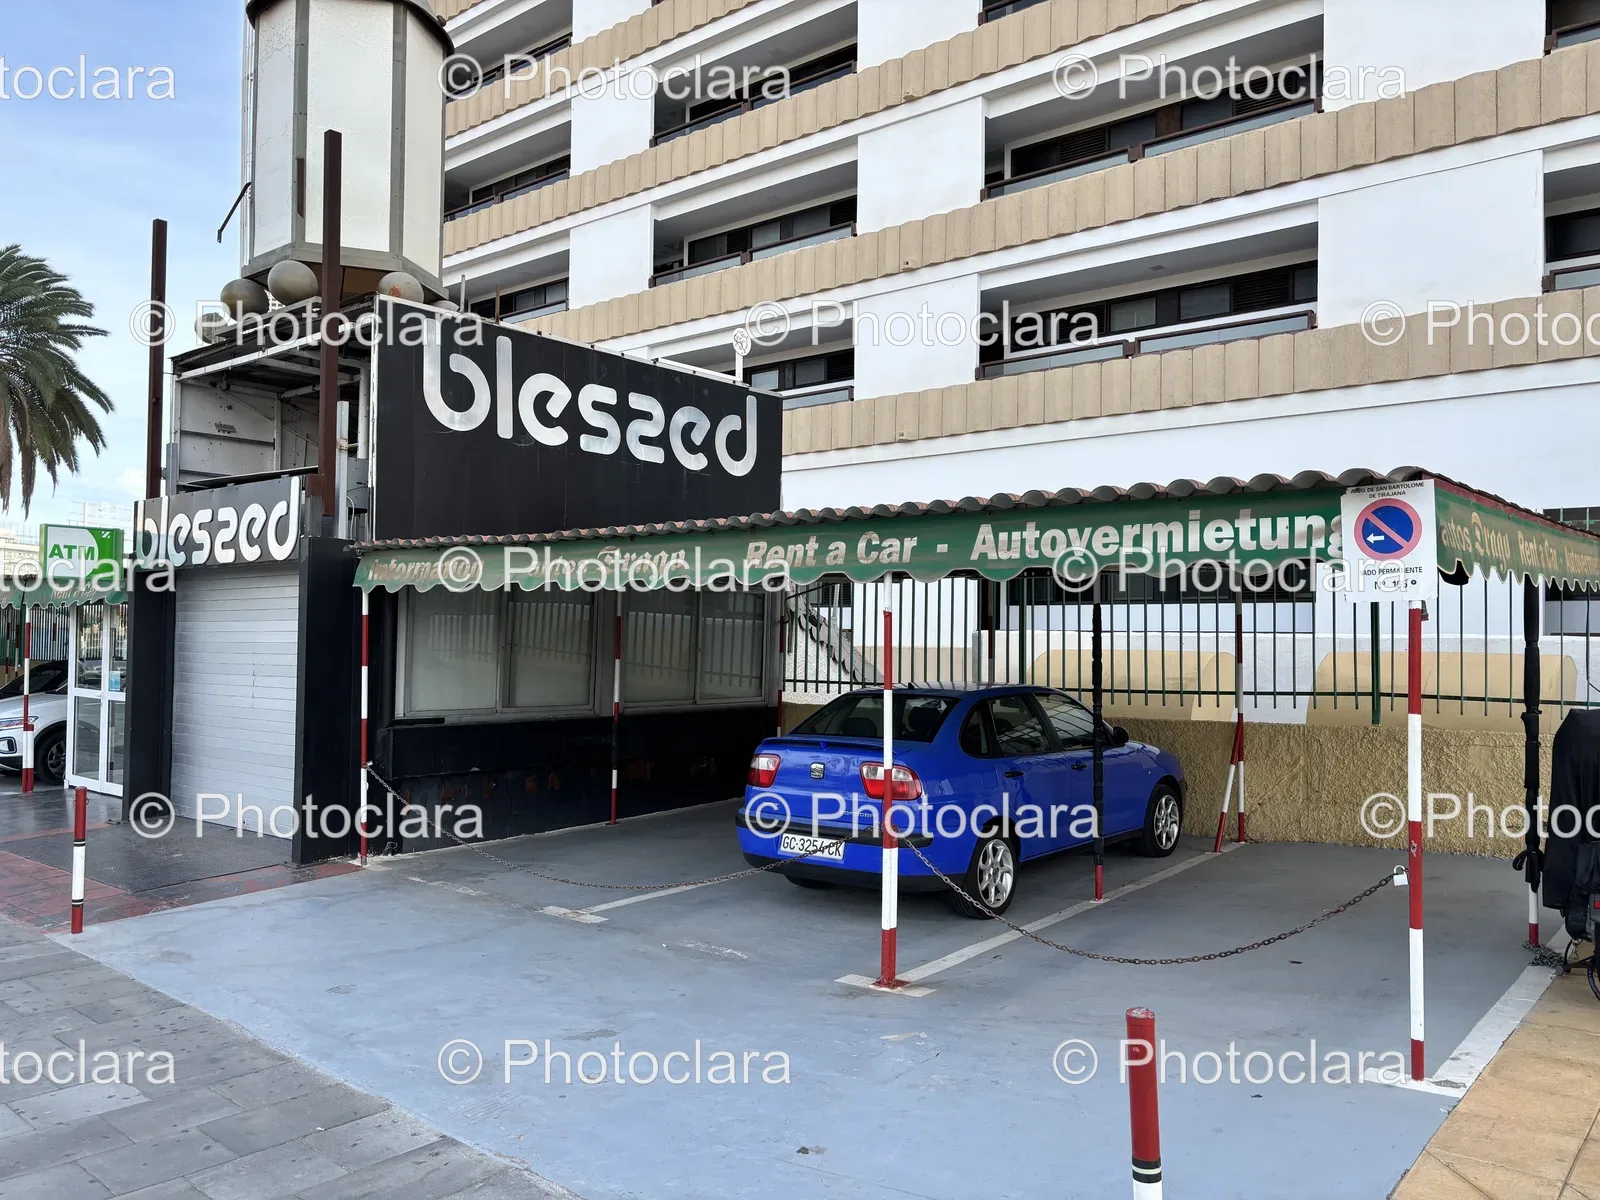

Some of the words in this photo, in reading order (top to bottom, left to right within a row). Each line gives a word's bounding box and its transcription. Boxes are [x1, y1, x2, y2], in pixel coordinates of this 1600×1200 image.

[49, 544, 95, 560] ATM
[746, 535, 819, 569] Rent
[825, 540, 847, 566] a
[857, 531, 918, 564] Car
[1517, 529, 1540, 567] Rent
